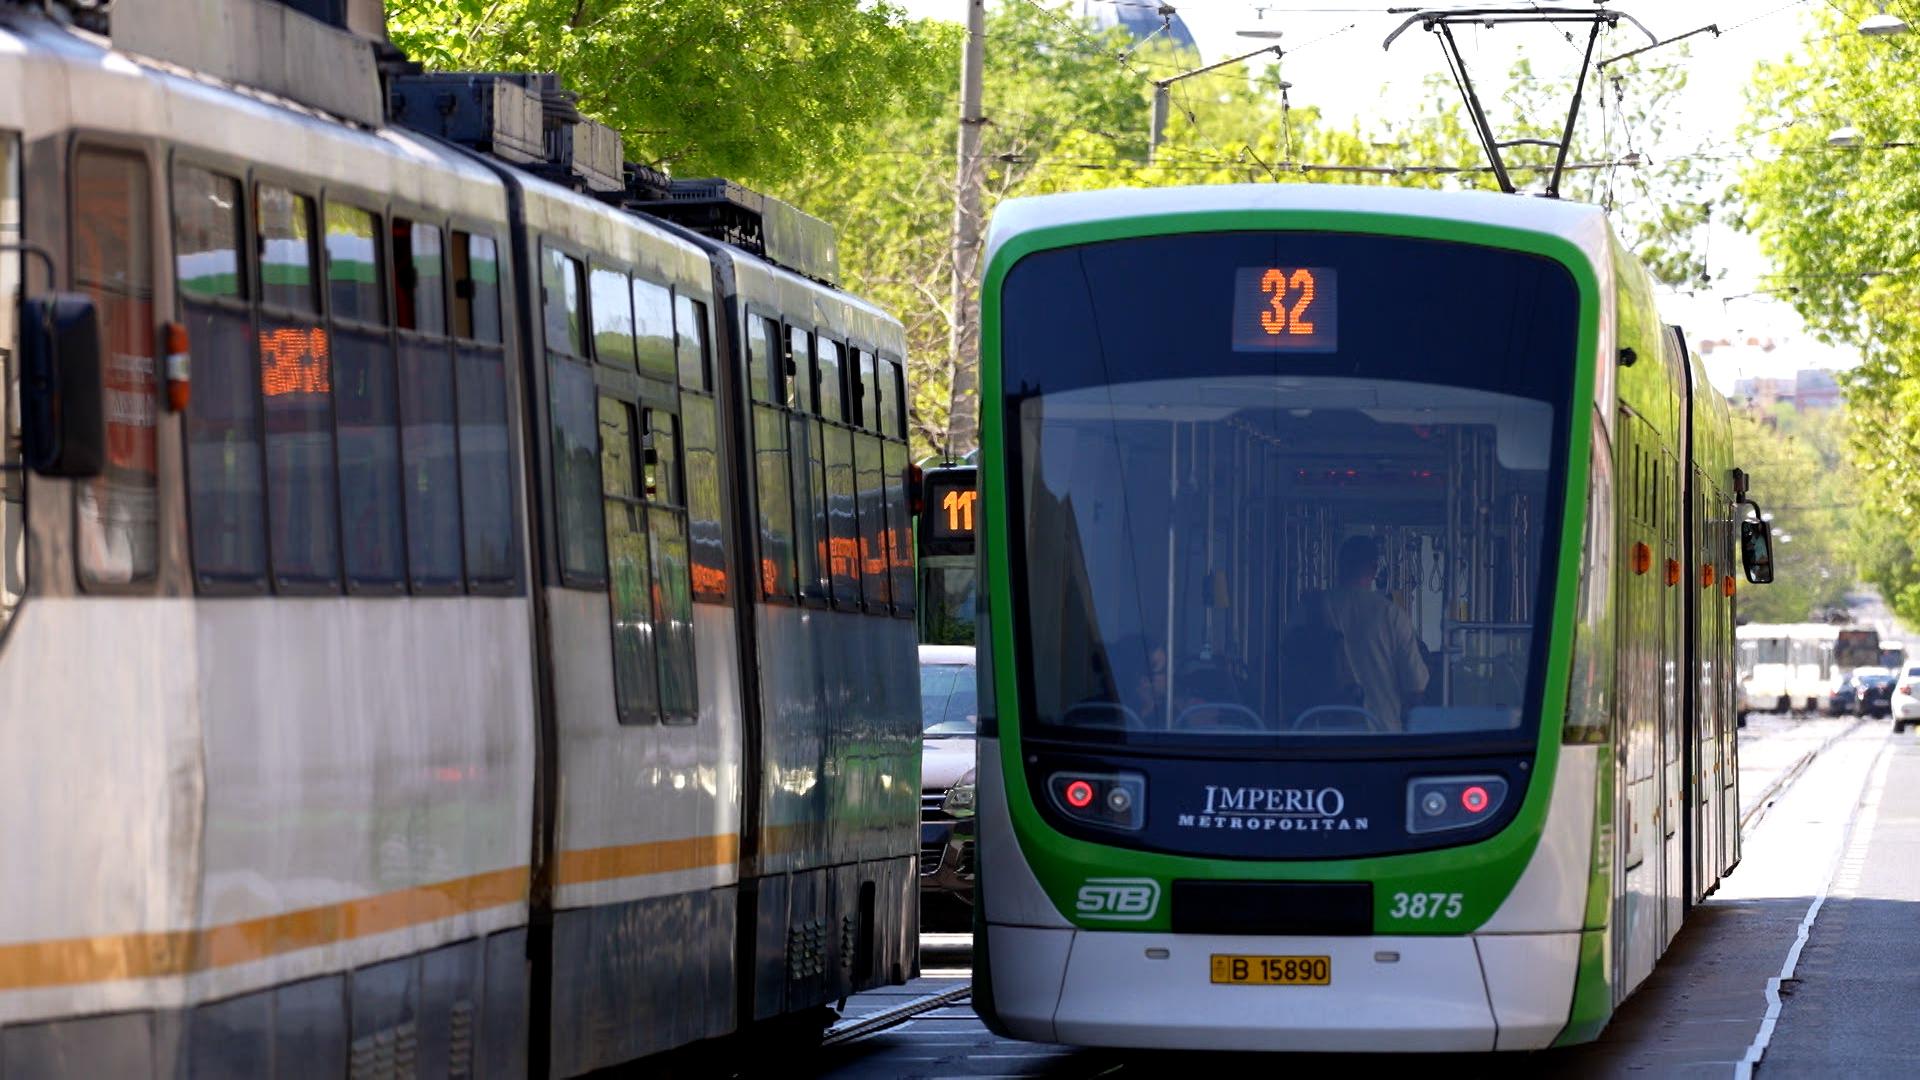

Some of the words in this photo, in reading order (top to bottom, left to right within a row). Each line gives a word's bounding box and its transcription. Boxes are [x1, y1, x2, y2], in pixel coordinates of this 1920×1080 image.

[1261, 268, 1314, 334] 32
[943, 490, 977, 530] 11
[1203, 785, 1345, 817] IMPERIO
[1178, 814, 1369, 831] METROPOLITAN
[1076, 885, 1152, 912] STB
[1390, 892, 1464, 918] 3875
[1232, 959, 1249, 980] B
[1261, 959, 1327, 981] 15890
